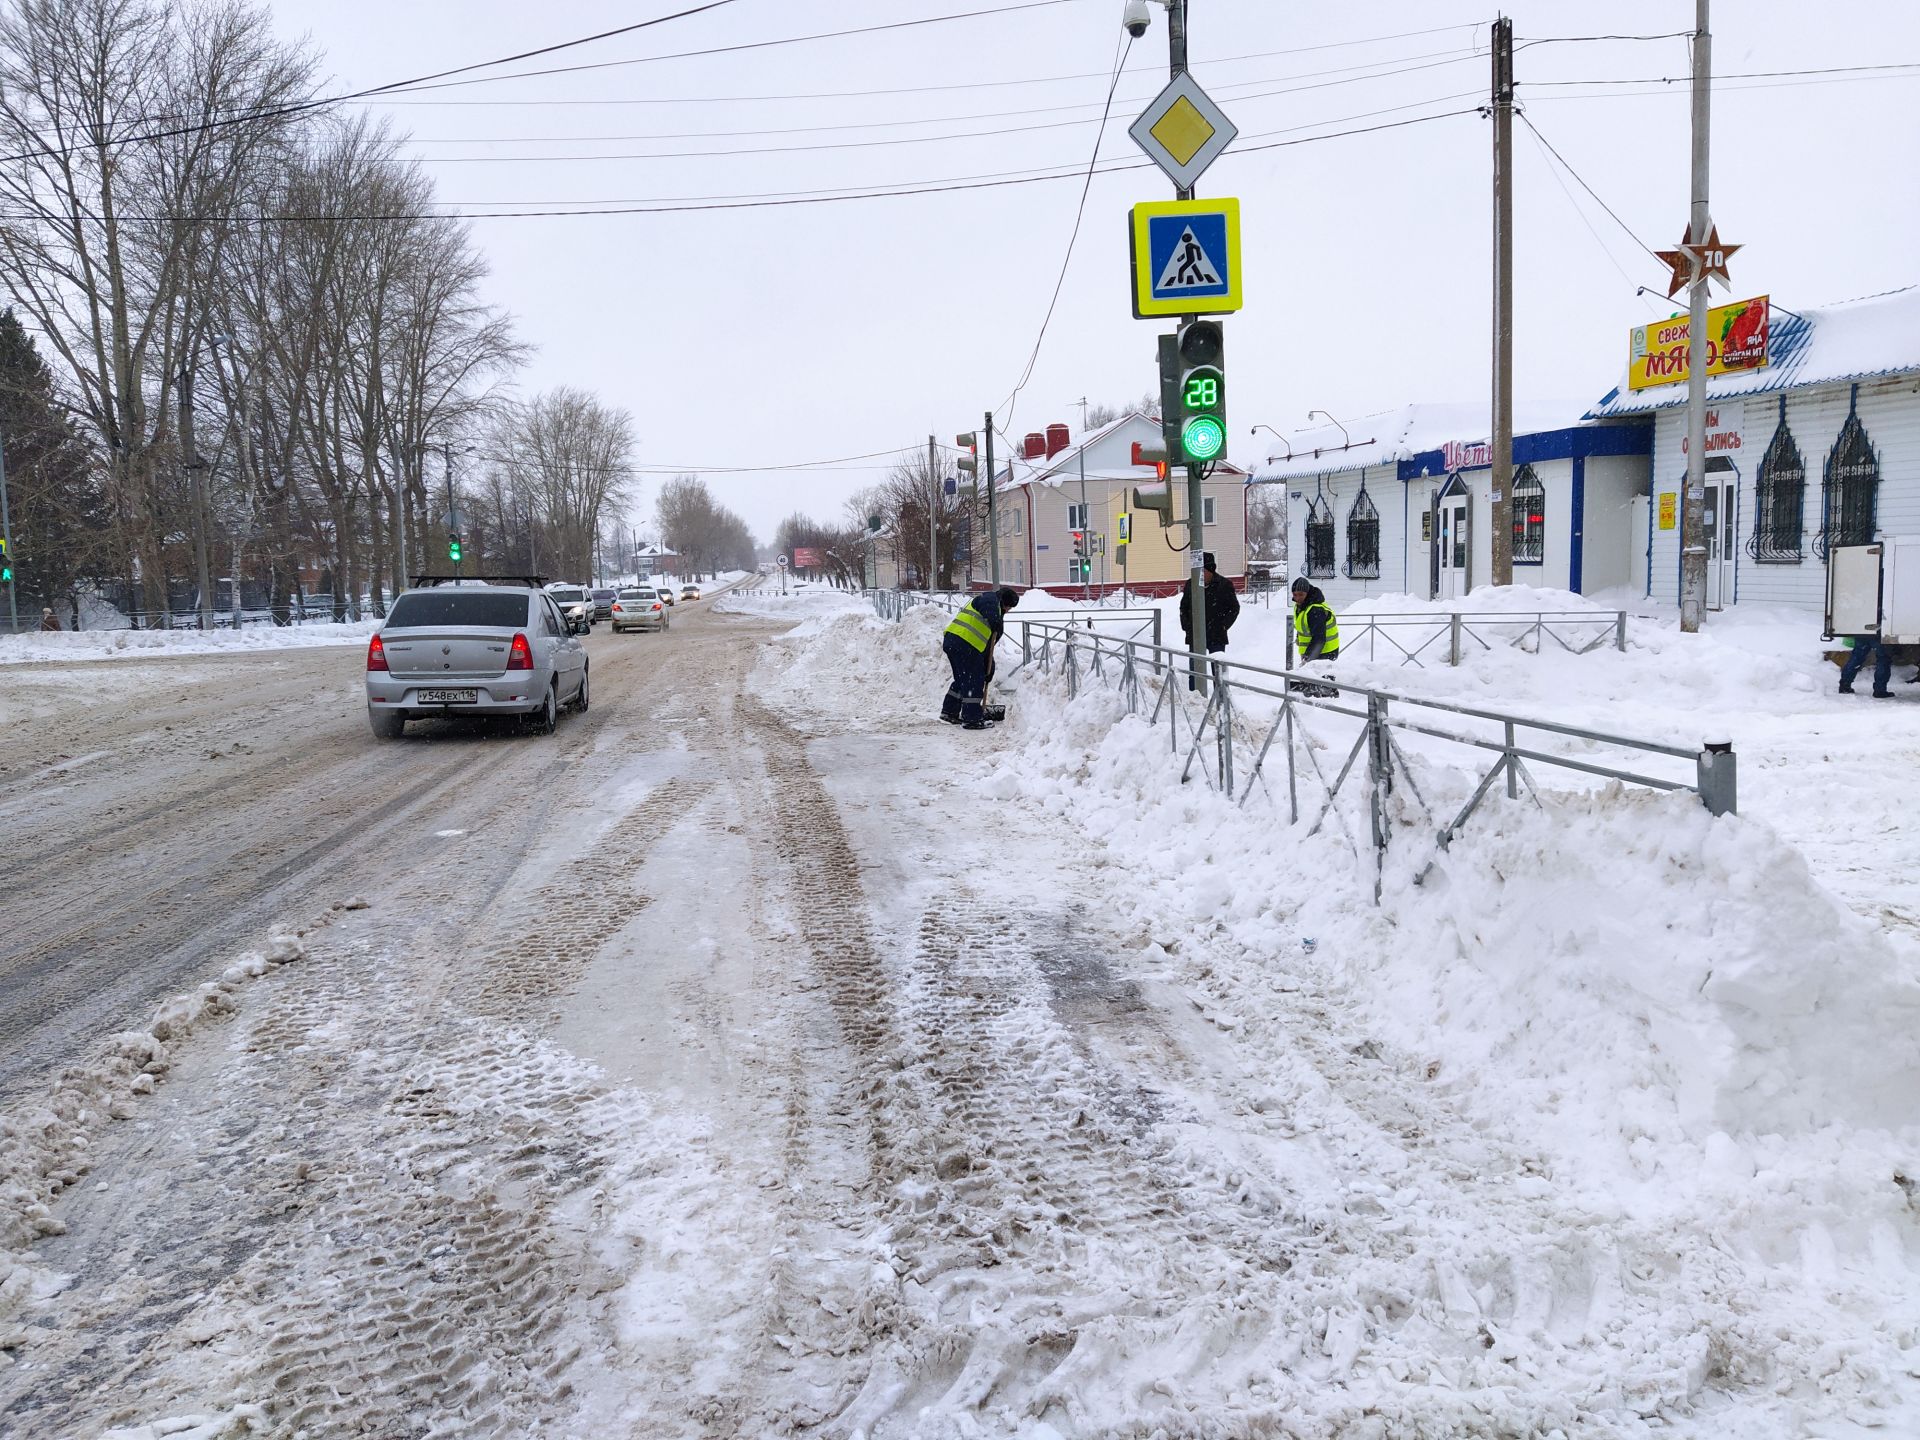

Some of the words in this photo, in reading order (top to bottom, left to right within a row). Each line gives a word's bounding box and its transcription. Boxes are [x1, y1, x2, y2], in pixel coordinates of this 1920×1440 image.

[1704, 250, 1724, 268] 70
[1658, 325, 1690, 344] свеж
[1188, 379, 1217, 406] 28
